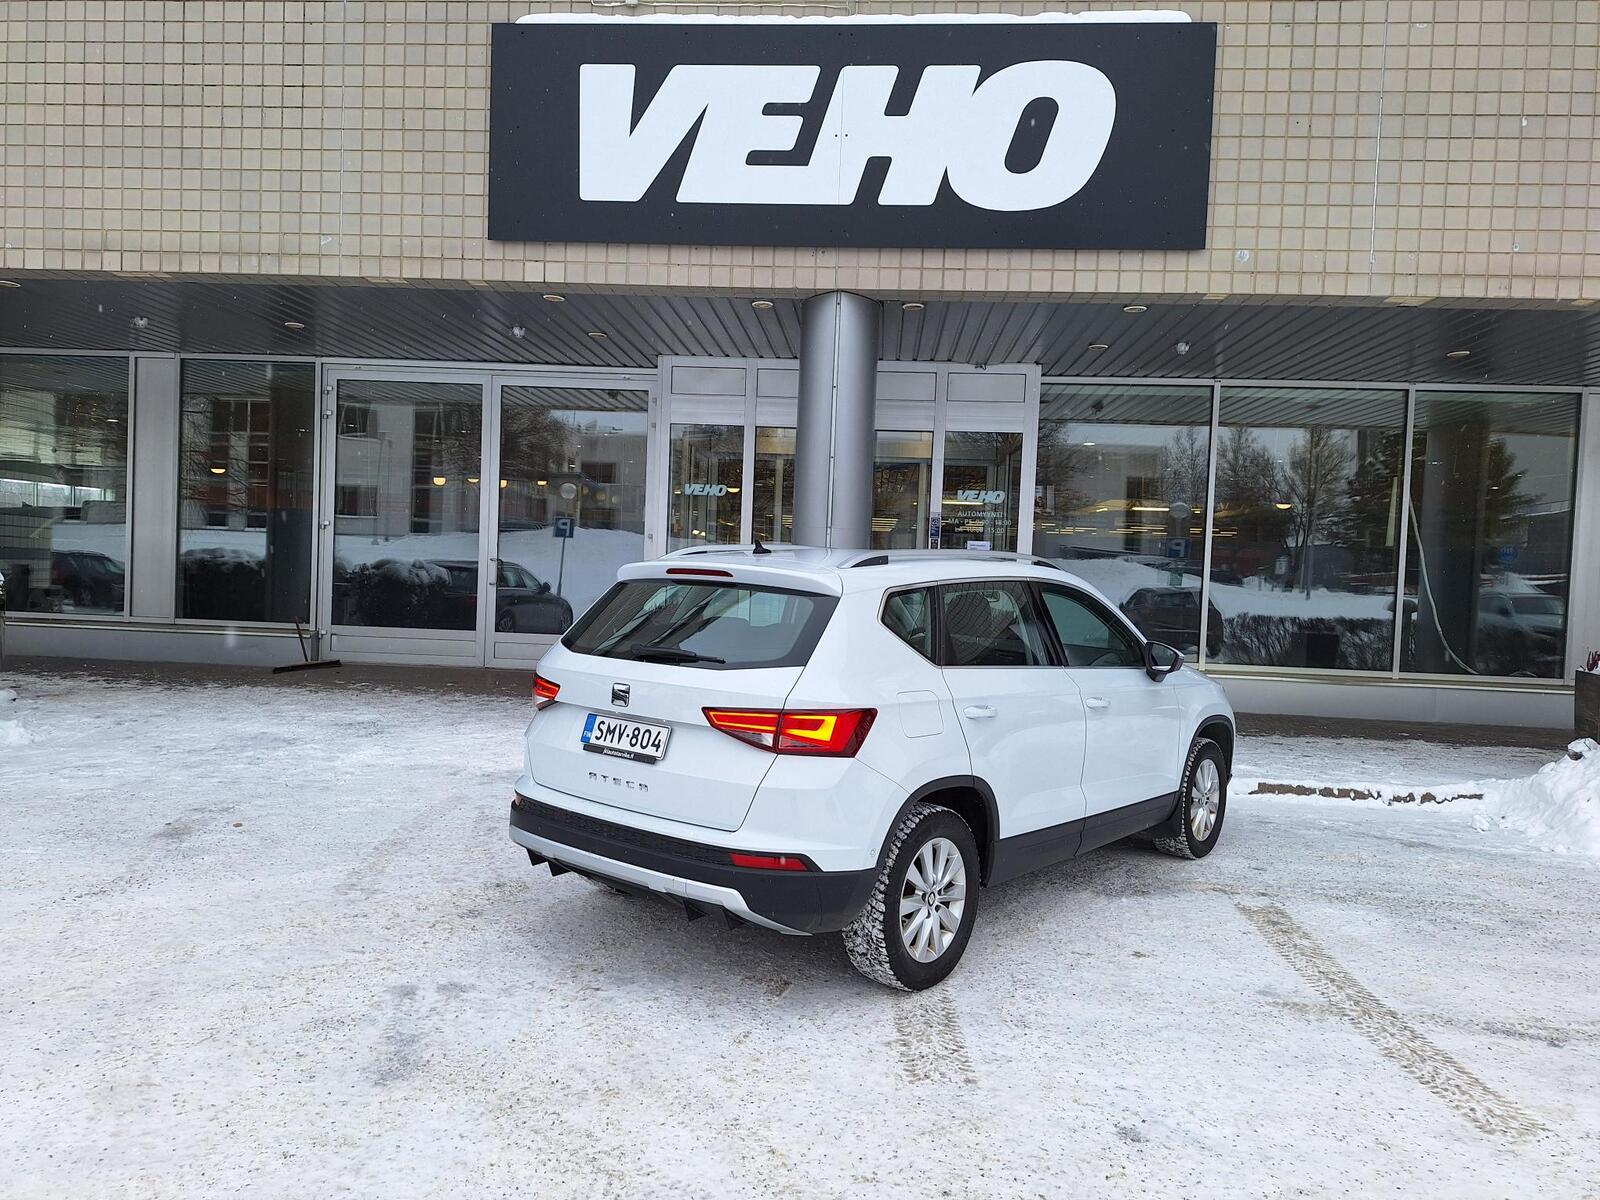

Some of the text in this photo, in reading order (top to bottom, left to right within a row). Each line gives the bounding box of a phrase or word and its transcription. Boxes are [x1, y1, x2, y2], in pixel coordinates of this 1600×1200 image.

[580, 60, 1117, 211] VEHO
[684, 483, 727, 496] VEHO
[957, 490, 1005, 504] VEHO
[588, 771, 649, 792] ATECA
